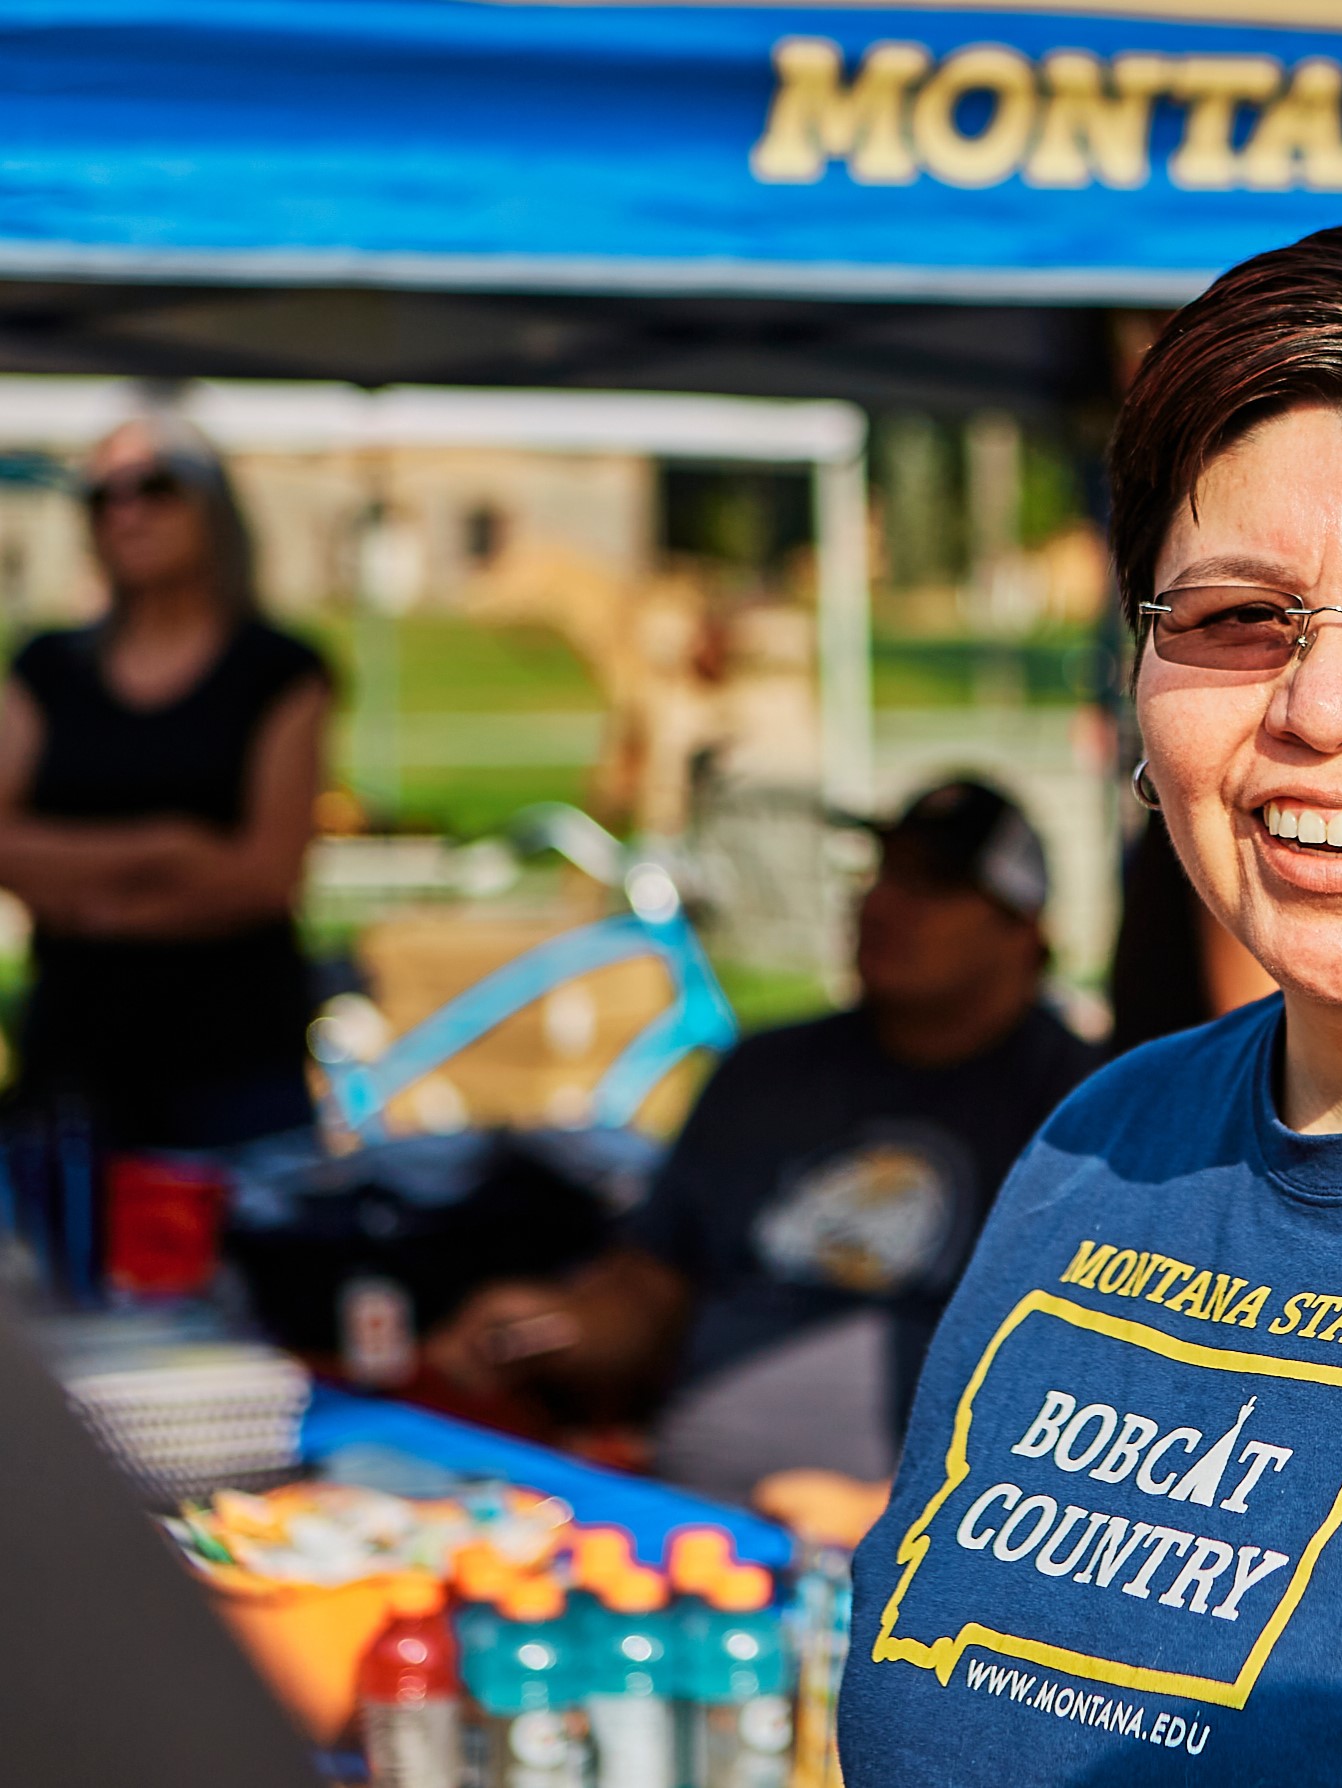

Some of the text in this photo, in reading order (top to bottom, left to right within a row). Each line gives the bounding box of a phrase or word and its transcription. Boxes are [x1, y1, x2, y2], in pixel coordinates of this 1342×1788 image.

[1061, 1240, 1273, 1328] MONTANA
[1012, 1390, 1293, 1513] BOBCAT
[957, 1483, 1289, 1620] COUNTRY
[966, 1659, 1211, 1755] WWW.MONTANA.EDU
